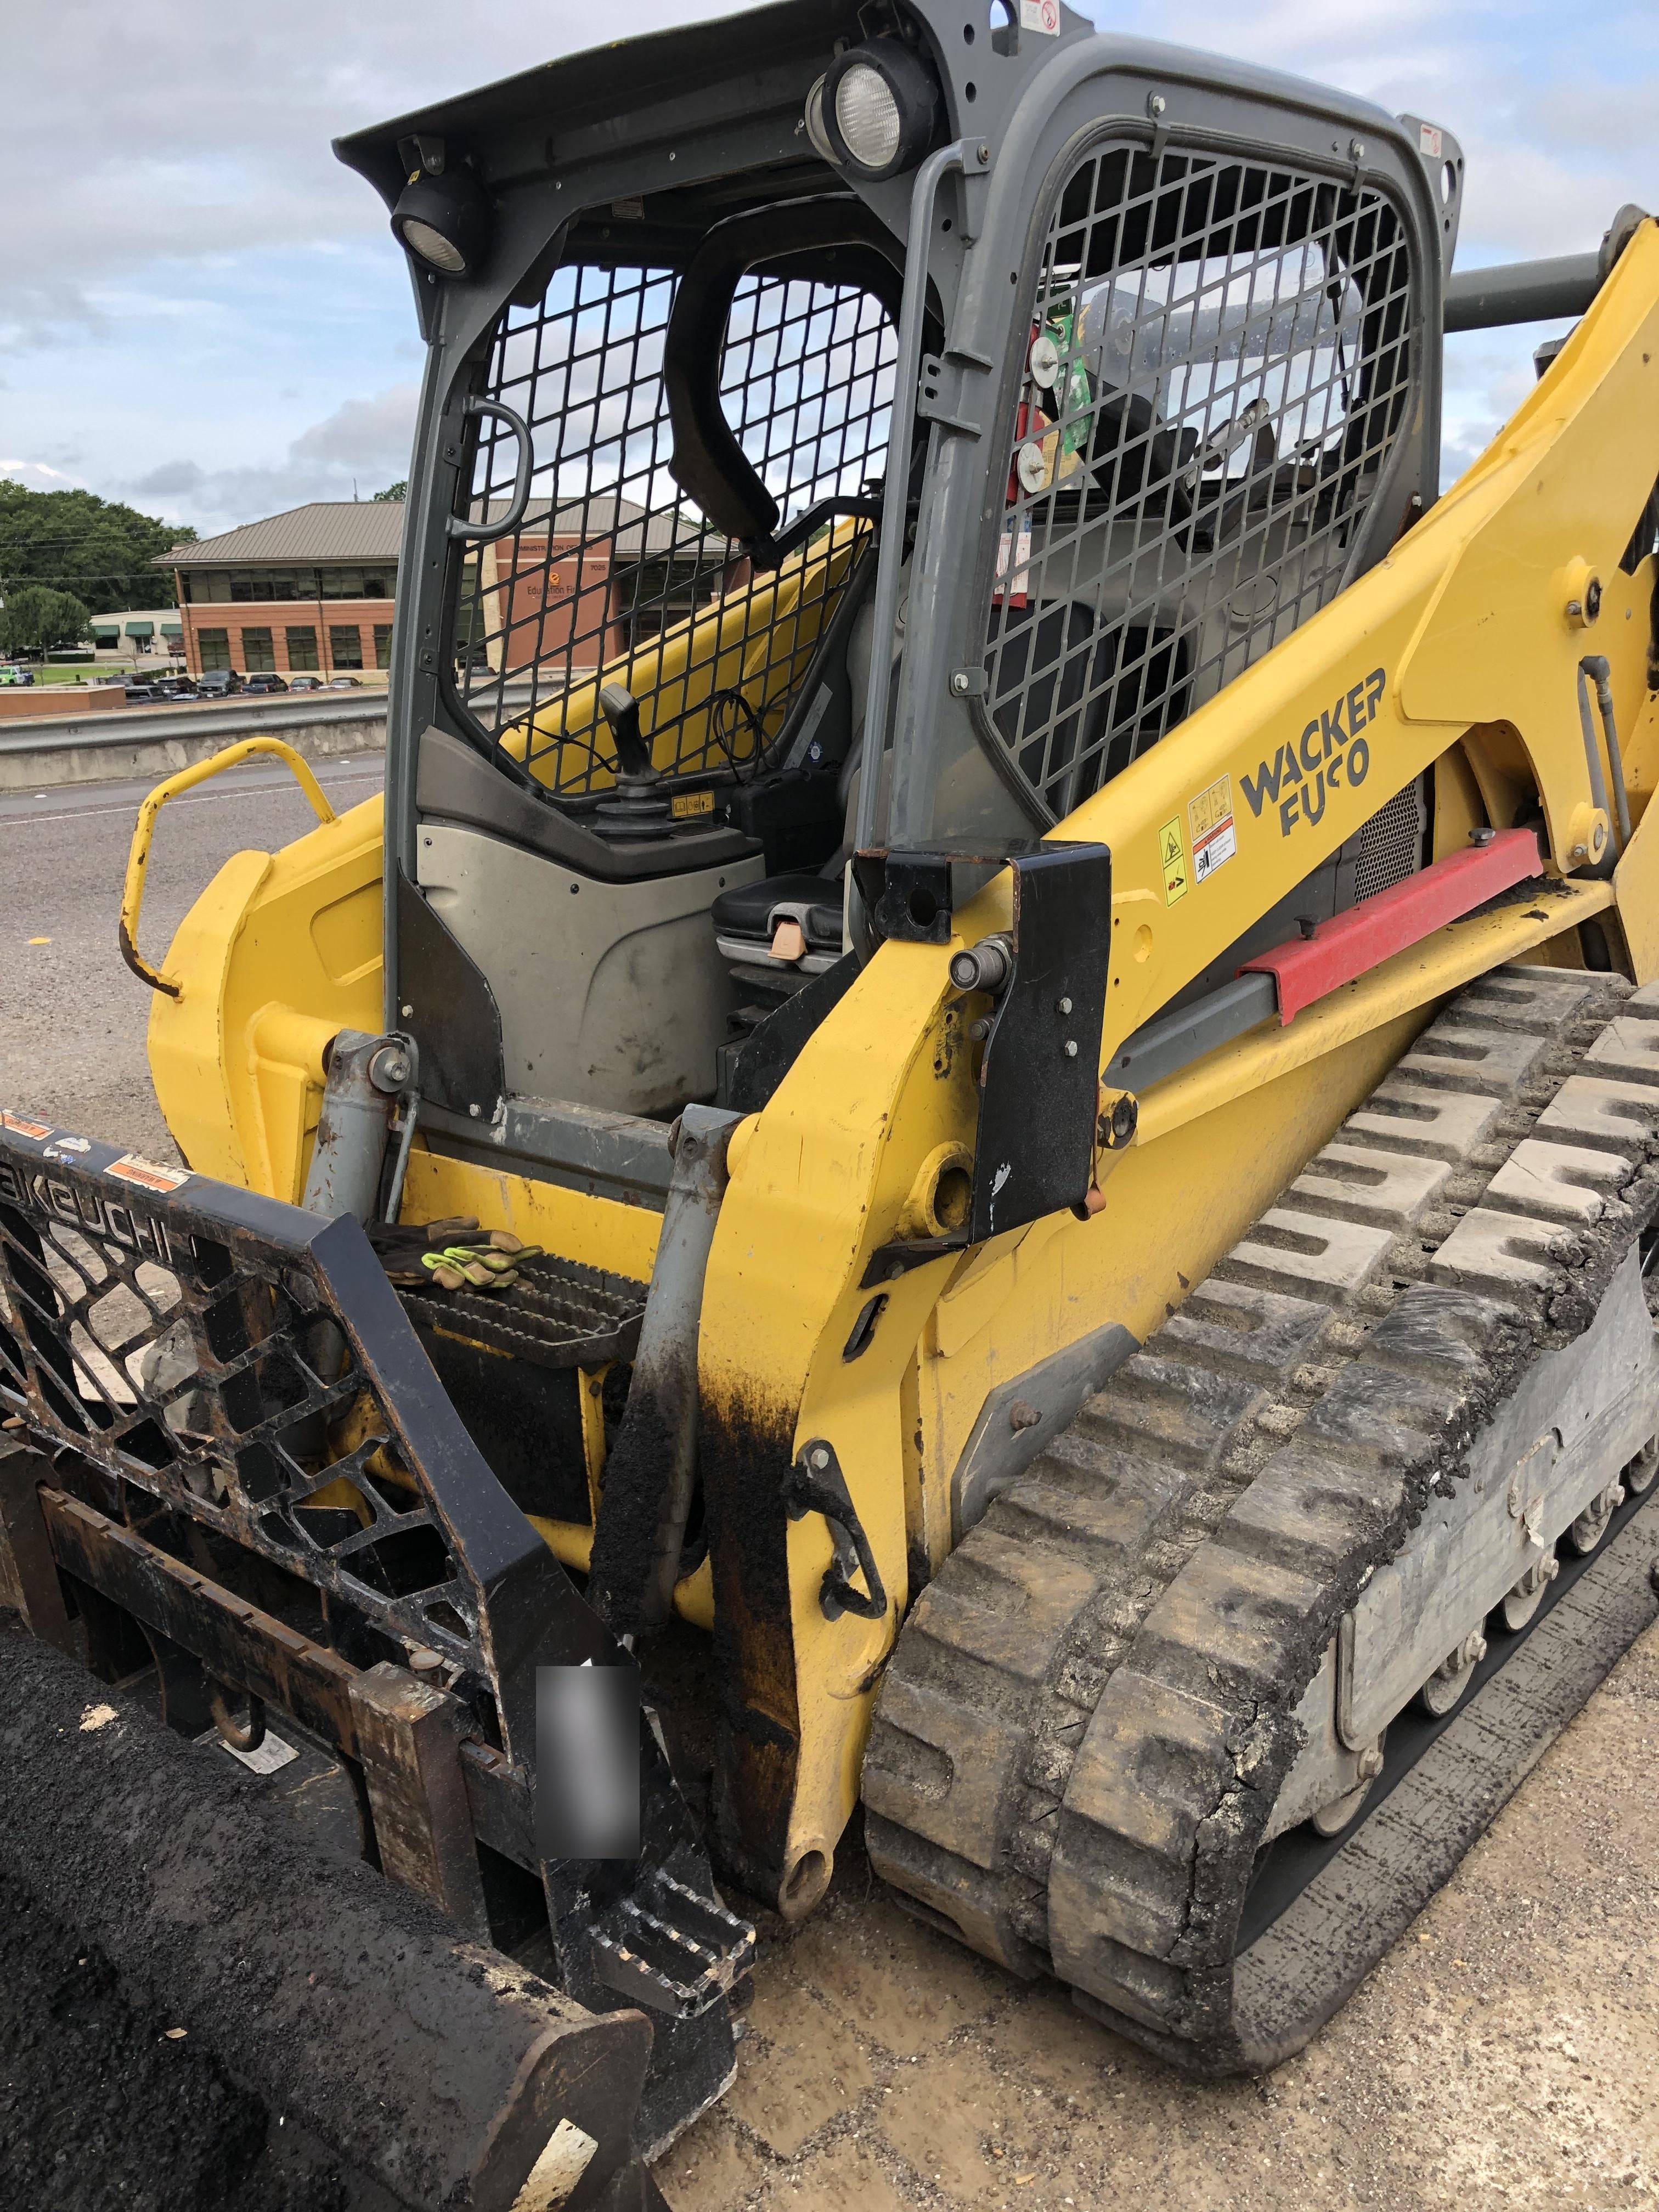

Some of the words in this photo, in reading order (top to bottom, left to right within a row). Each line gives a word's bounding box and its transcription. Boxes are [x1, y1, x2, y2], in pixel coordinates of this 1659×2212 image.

[527, 586, 564, 595] Eduation
[1239, 668, 1386, 818] WACKER
[126, 1169, 156, 1182] WARNING
